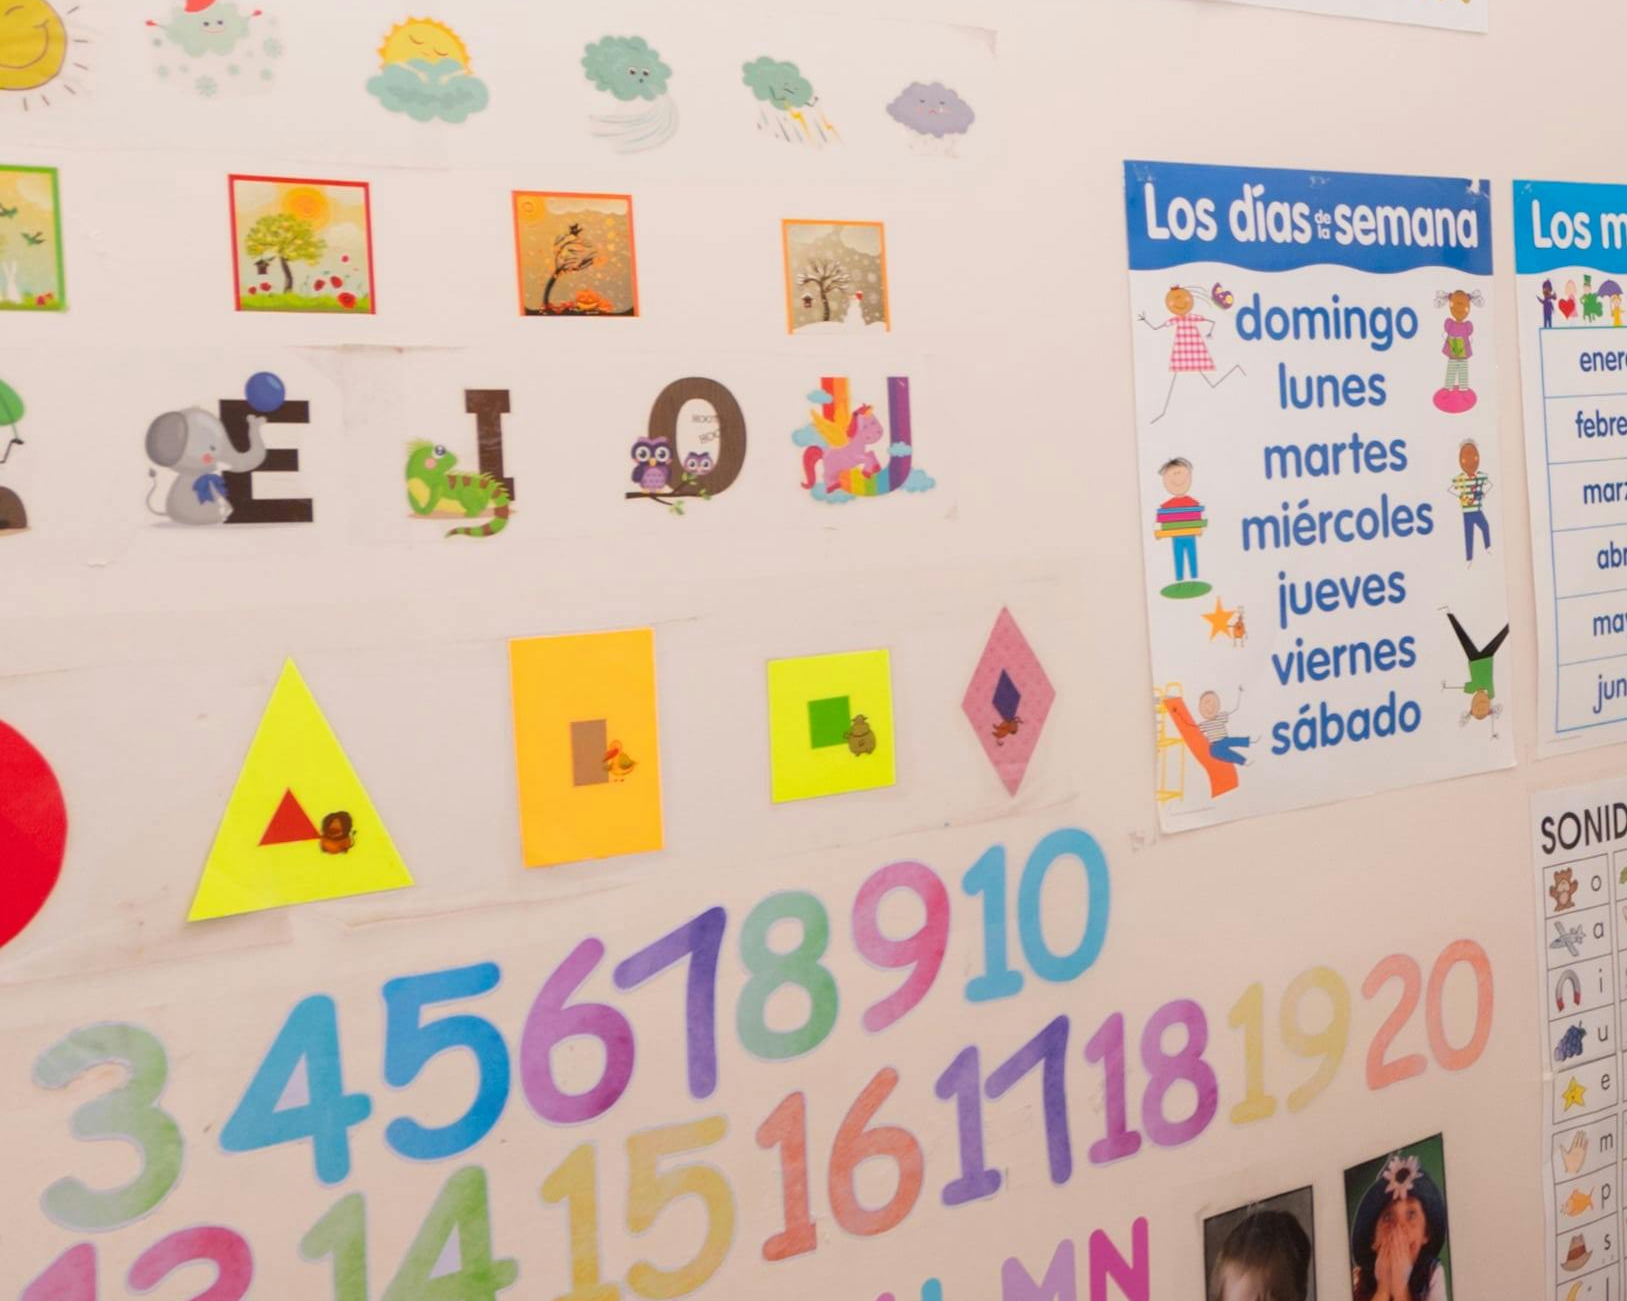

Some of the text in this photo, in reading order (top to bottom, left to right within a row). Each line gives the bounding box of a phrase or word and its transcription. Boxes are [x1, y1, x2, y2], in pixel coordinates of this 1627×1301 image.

[1144, 182, 1478, 248] Los días de la semana
[1532, 199, 1592, 249] Los
[1235, 292, 1419, 352] domingo
[1278, 362, 1387, 410] lunes
[1263, 431, 1408, 480] martes
[1241, 492, 1434, 551] miércoles
[1277, 570, 1407, 630] jueves
[1272, 635, 1417, 686] viernes
[1271, 690, 1421, 756] sábado
[1591, 874, 1602, 892] o
[1593, 921, 1604, 939] a
[33, 827, 1110, 1232] 3 4 5 6 7 8 9 10
[1597, 1024, 1609, 1043] u
[755, 1067, 925, 1262] 16
[935, 1014, 1072, 1207] 17
[1084, 999, 1219, 1165] 18
[1227, 965, 1351, 1126] 19
[1361, 939, 1494, 1090] 20
[1600, 1073, 1611, 1090] e
[1599, 1132, 1614, 1153] m
[1601, 1183, 1611, 1210] p
[1603, 1234, 1611, 1250] s
